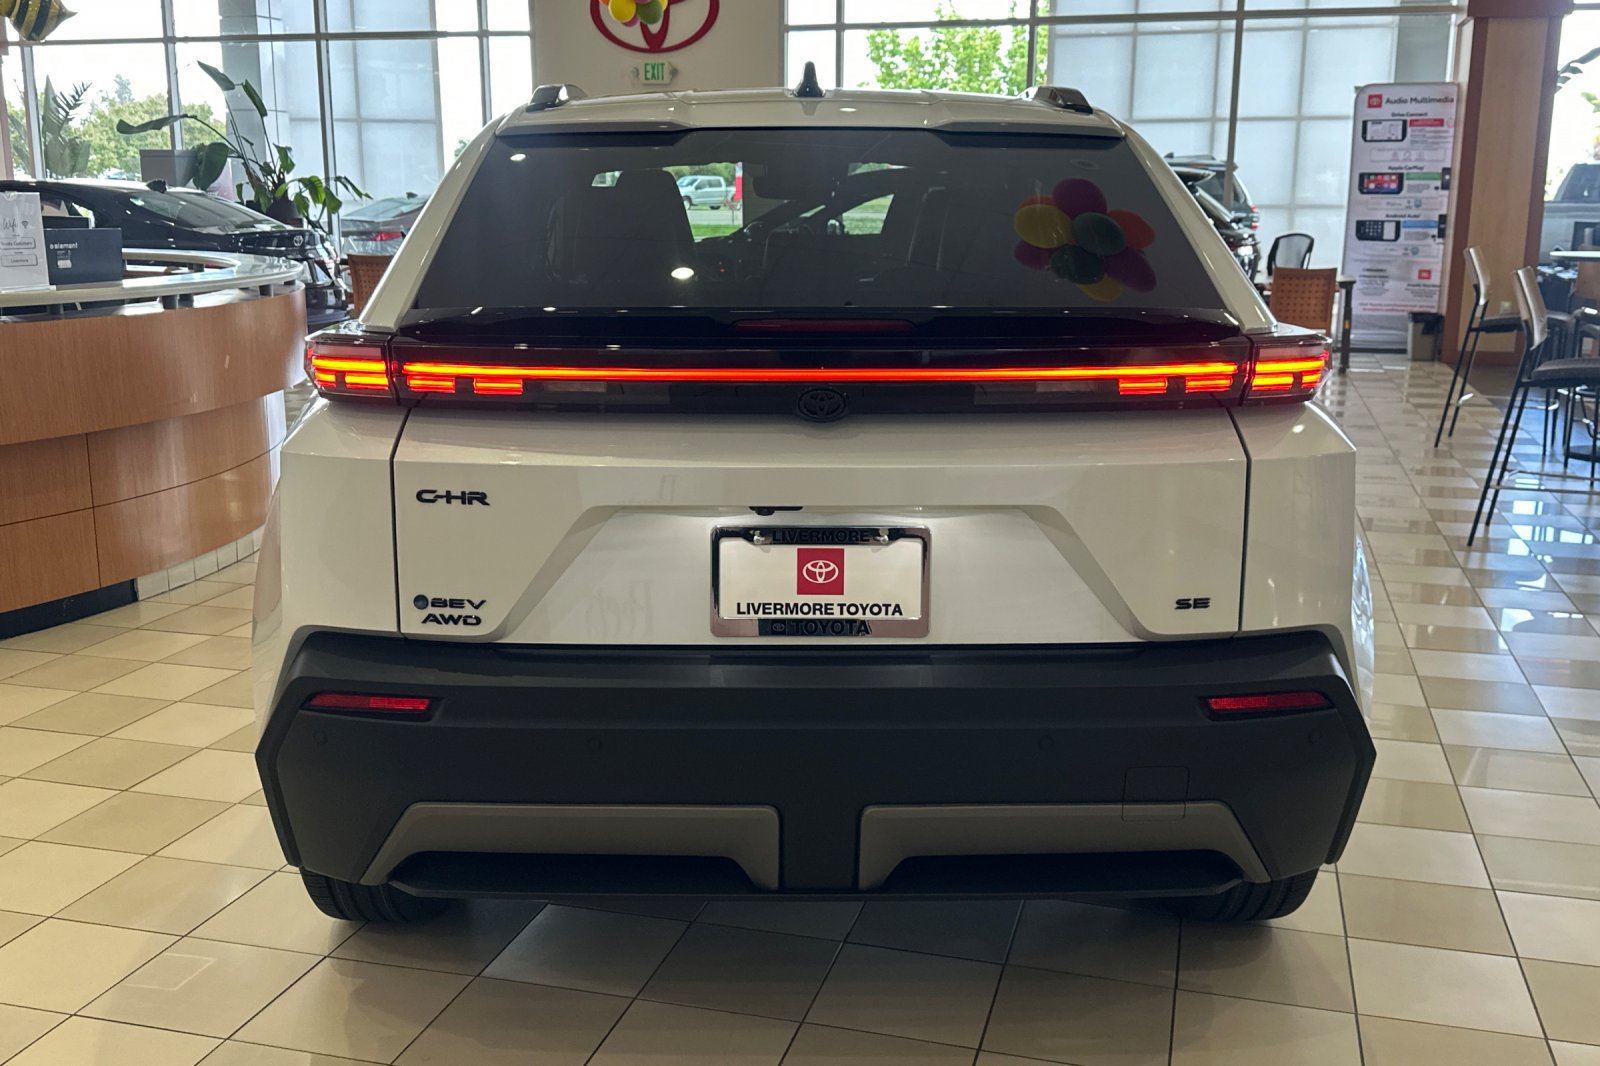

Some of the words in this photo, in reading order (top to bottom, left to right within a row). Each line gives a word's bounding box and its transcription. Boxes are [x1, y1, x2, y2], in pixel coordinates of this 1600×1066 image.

[644, 63, 665, 81] EXIT
[1385, 96, 1408, 105] Audio
[1410, 95, 1454, 104] Multimedia
[415, 489, 491, 506] C-HR
[772, 528, 871, 543] LIVERMORE
[736, 602, 834, 616] LIVERMORE
[837, 602, 903, 616] TOYOTA
[1174, 597, 1211, 610] SE
[421, 613, 482, 626] AWD
[793, 620, 872, 636] TOYOTA
